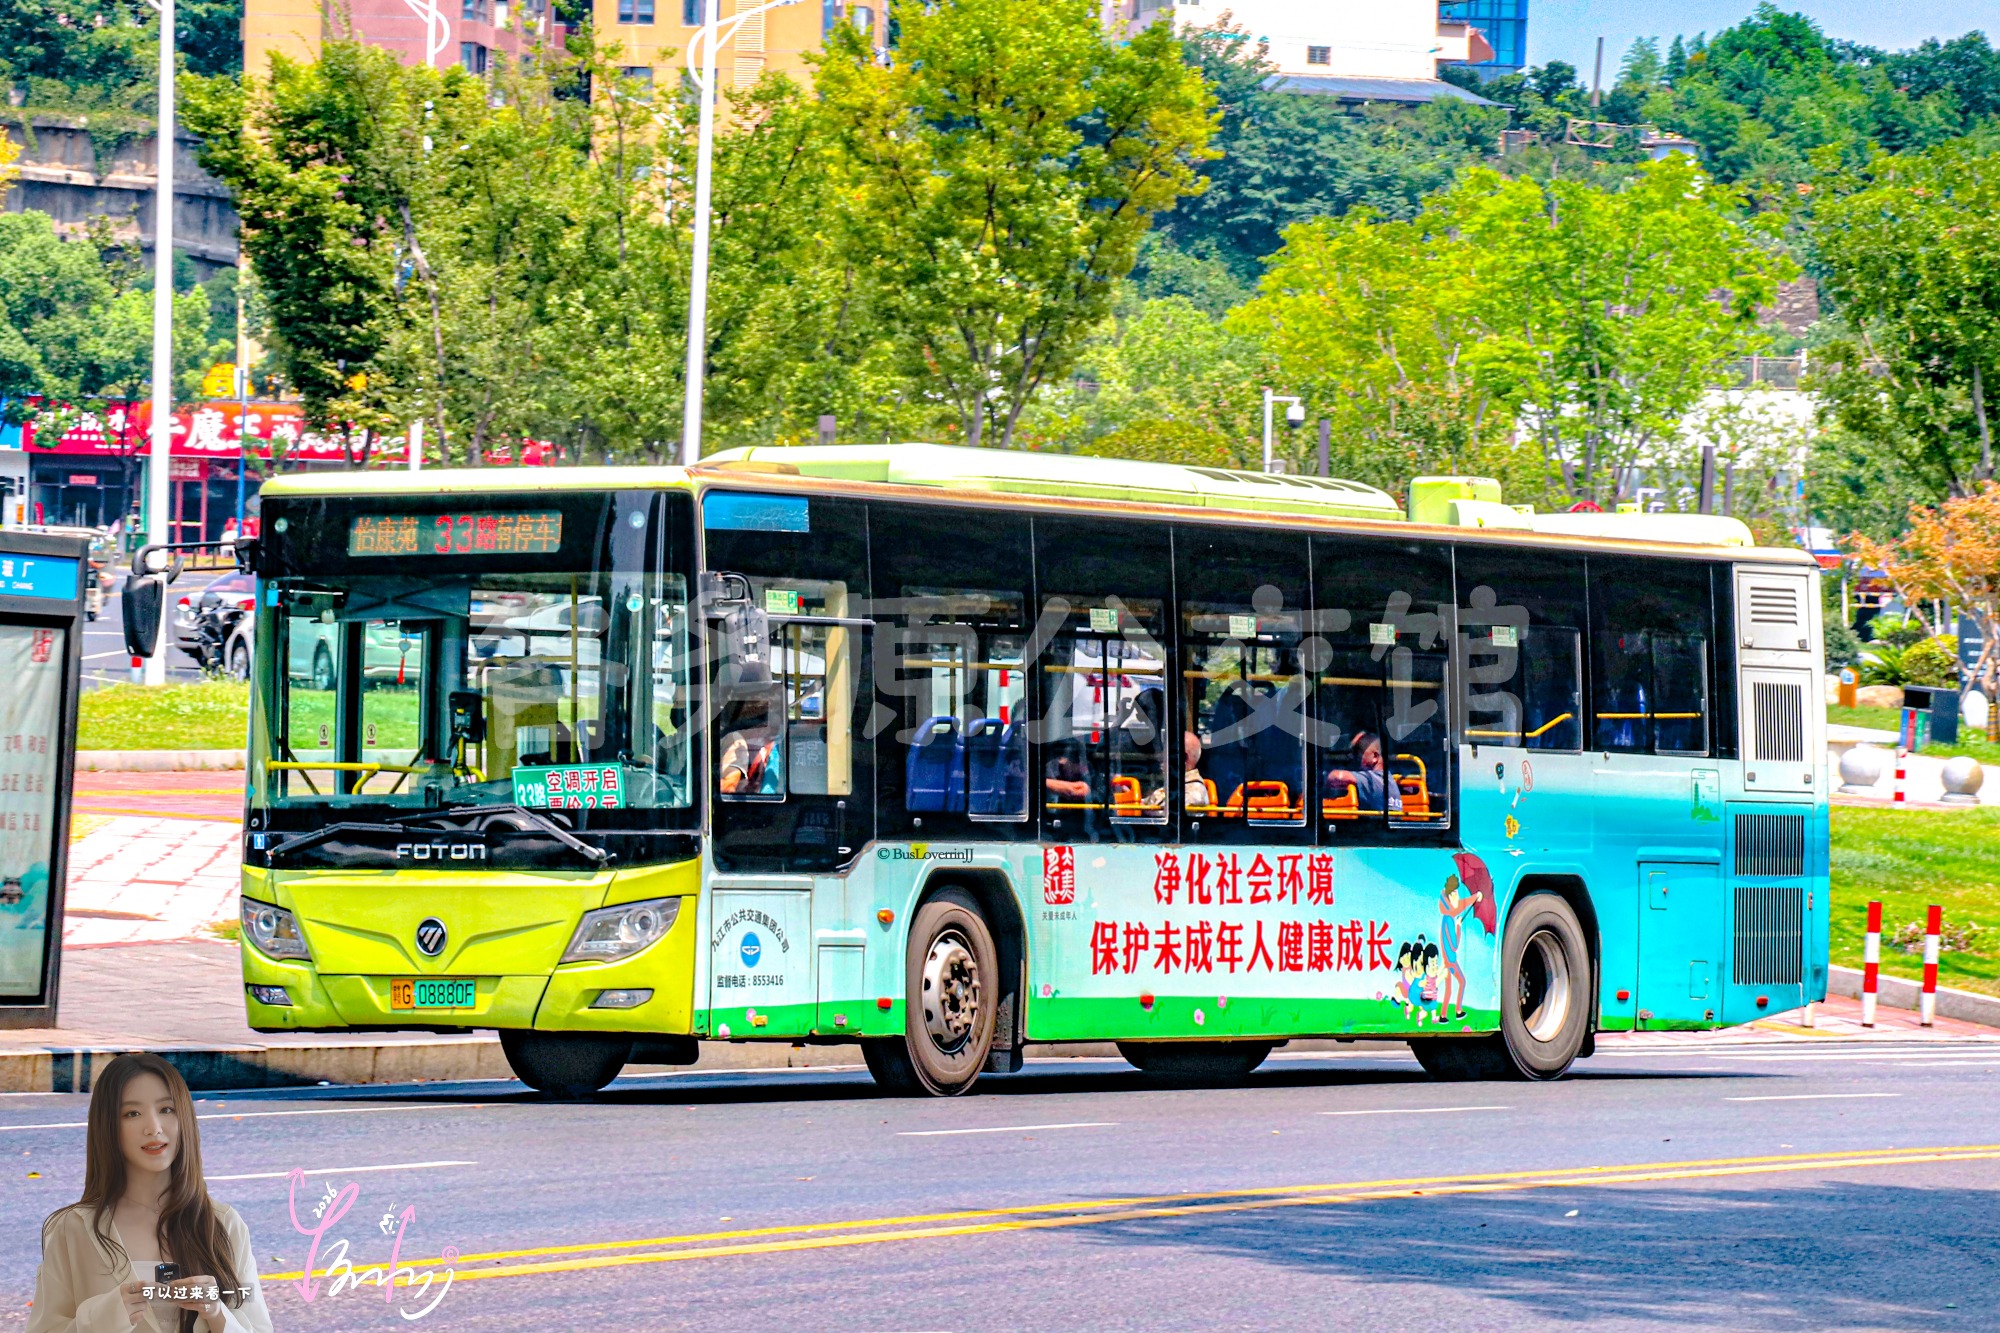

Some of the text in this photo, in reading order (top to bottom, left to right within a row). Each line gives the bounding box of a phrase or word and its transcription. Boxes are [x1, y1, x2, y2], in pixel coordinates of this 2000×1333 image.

[434, 515, 498, 553] 33路
[547, 769, 618, 792] 空调开启
[396, 843, 486, 860] FOTON
[1153, 852, 1335, 906] 净化社会环境
[711, 908, 790, 954] 九江市公共交通集团公司
[1089, 920, 1394, 976] 保护未成年人健康成长
